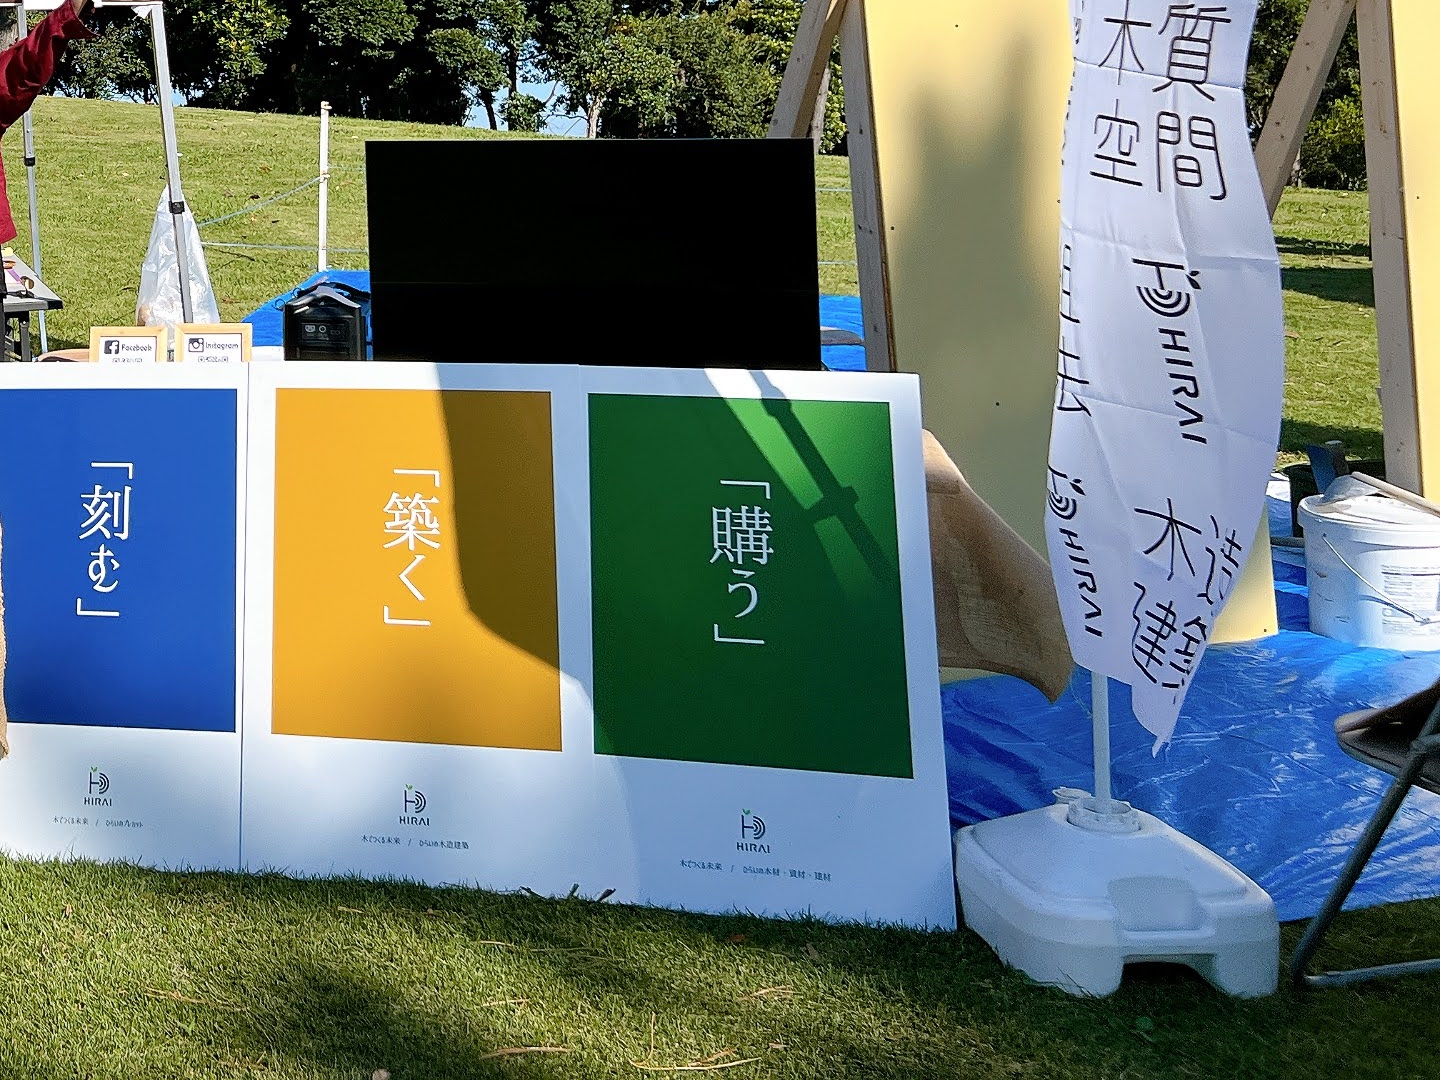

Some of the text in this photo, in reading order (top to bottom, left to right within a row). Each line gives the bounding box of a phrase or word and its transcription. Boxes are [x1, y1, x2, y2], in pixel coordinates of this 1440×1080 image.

[1089, 98, 1227, 200] 空間
[121, 344, 153, 352] Facebook
[1158, 328, 1208, 445] HIRAI
[1059, 527, 1103, 638] HIRAI
[83, 796, 113, 807] HIRAI
[399, 816, 430, 826] HIRAI
[736, 841, 771, 854] HIRAI
